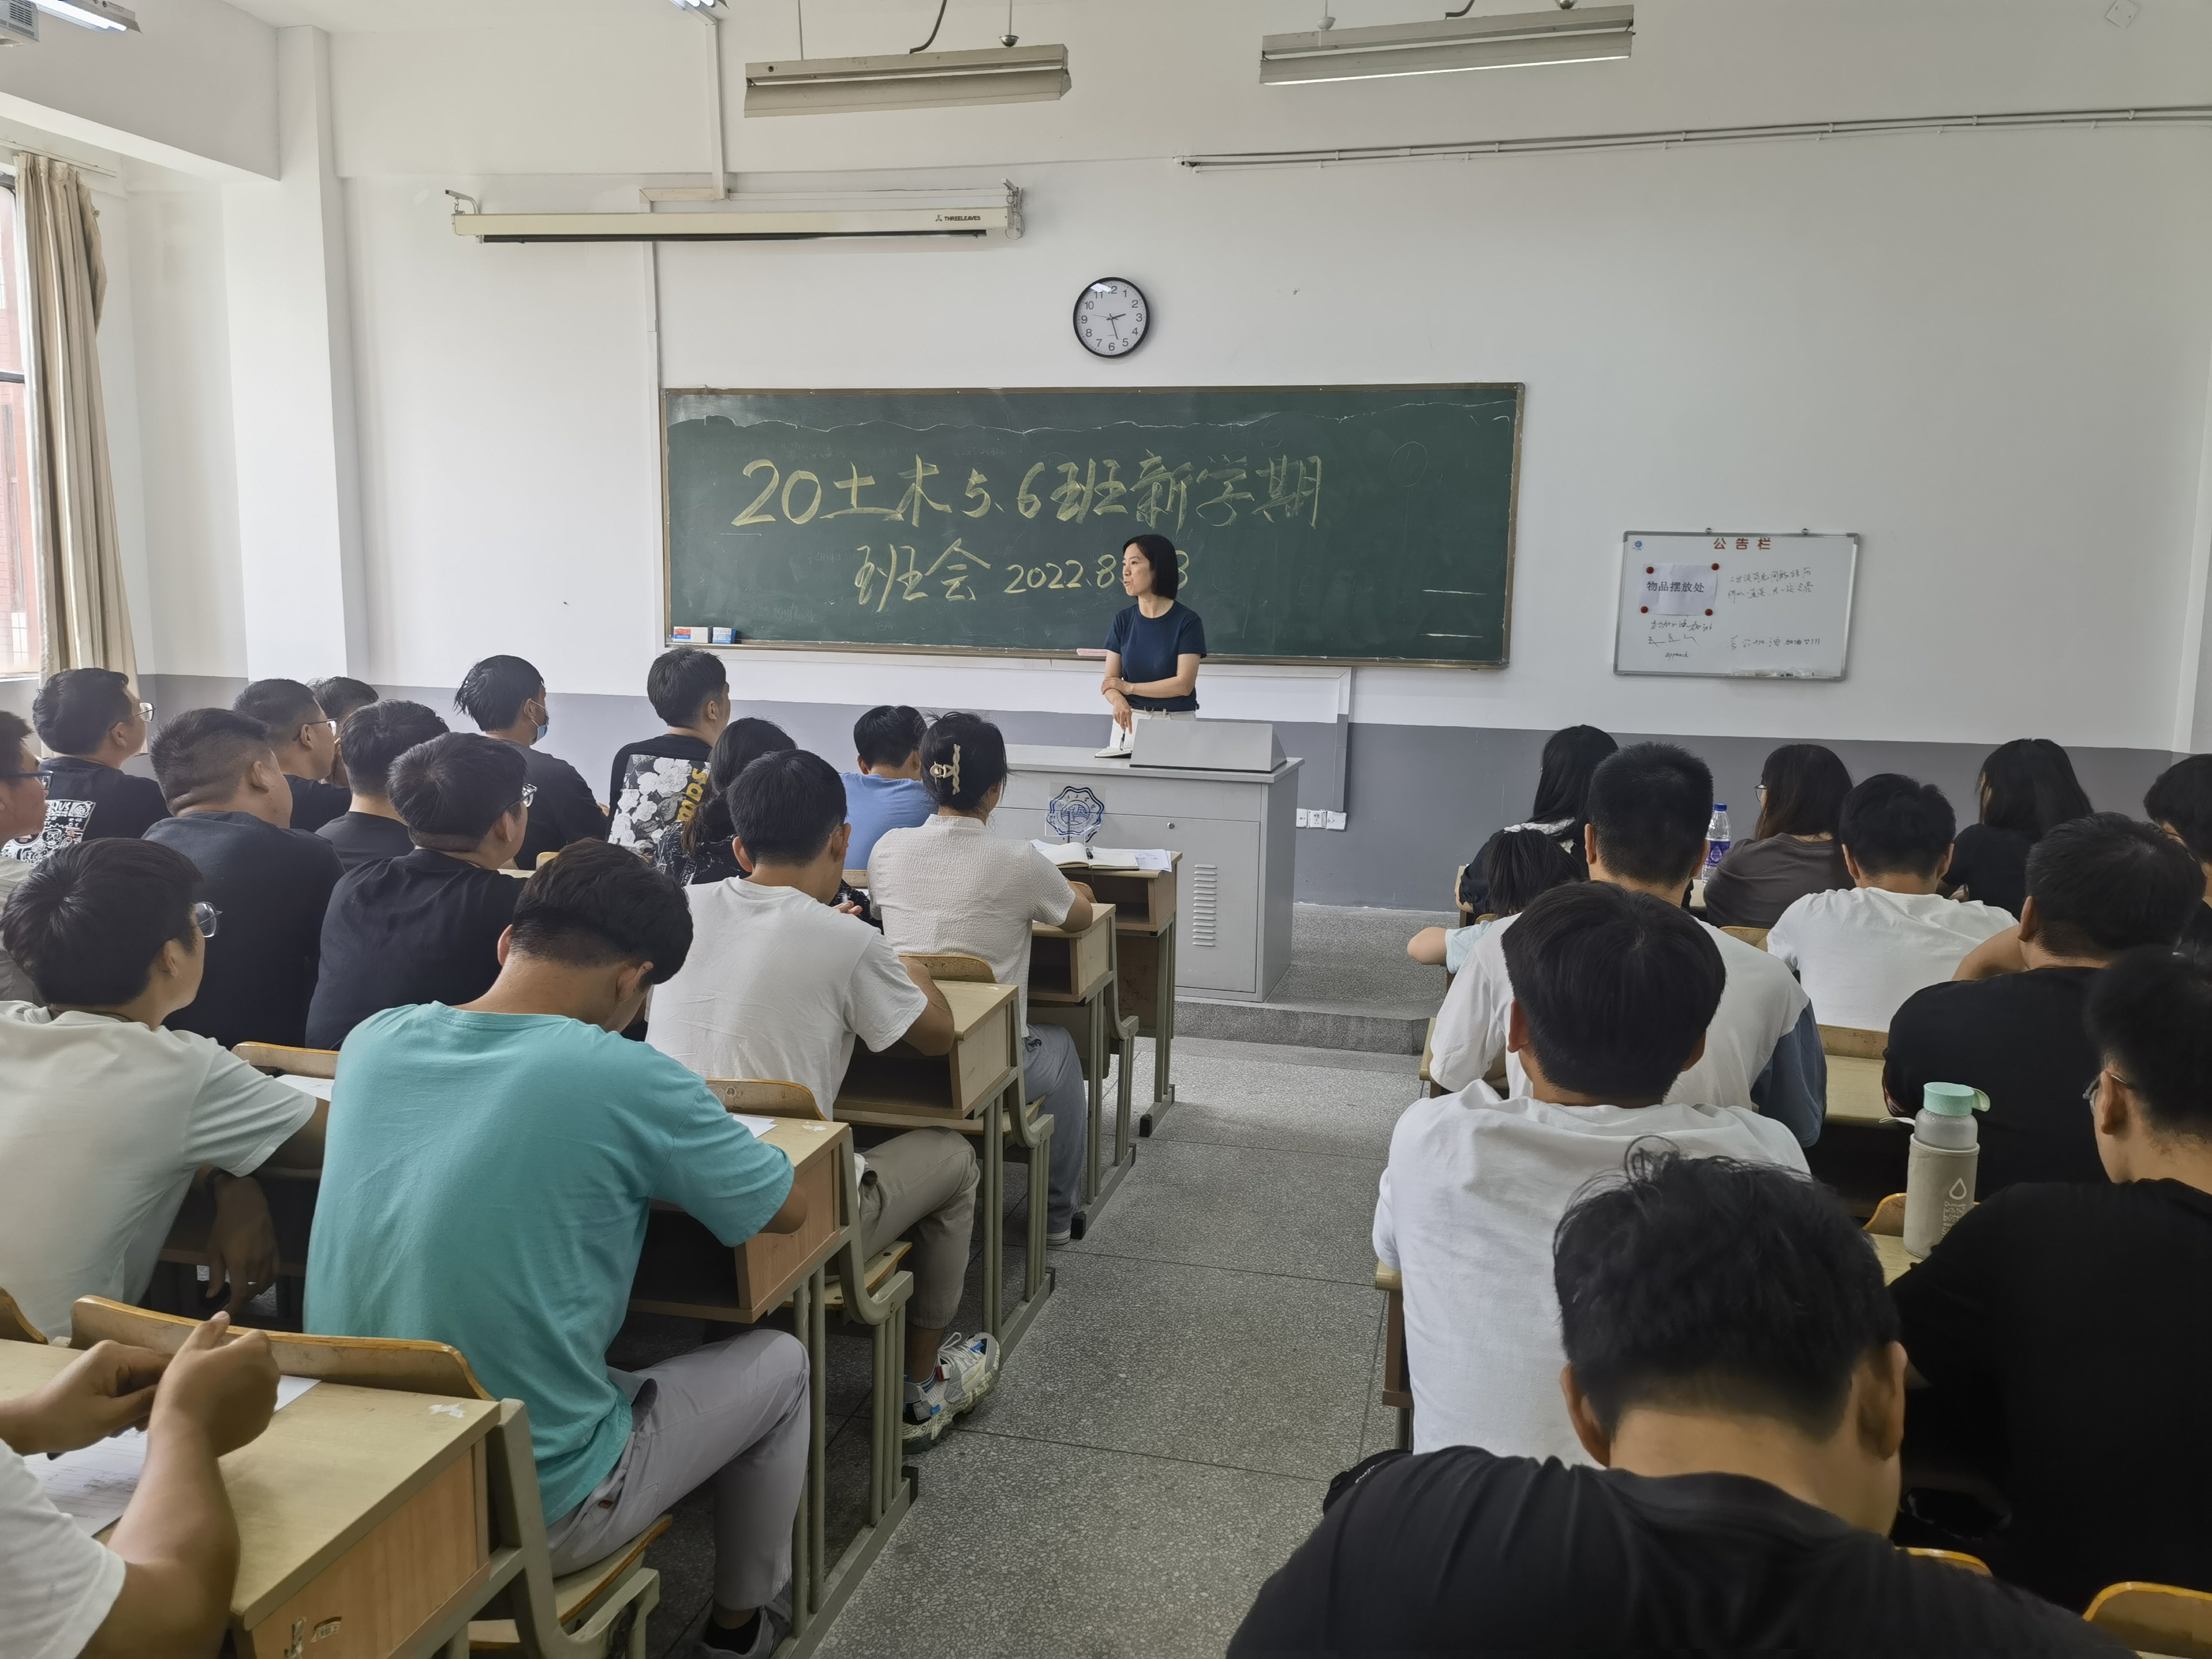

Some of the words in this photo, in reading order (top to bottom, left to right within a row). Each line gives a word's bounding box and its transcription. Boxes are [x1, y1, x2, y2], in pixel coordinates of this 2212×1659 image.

[1123, 289, 1127, 298] 1
[1084, 301, 1094, 310] 10
[1131, 300, 1138, 308] 2
[1081, 315, 1088, 324] 9
[1136, 313, 1142, 322] 3
[1085, 328, 1092, 337] 8
[1132, 327, 1138, 335] 4
[1096, 339, 1102, 347] 7
[1108, 342, 1115, 351] 6
[1122, 338, 1129, 347] 5
[1714, 537, 1771, 550] 公告栏
[853, 537, 992, 613] 班会
[1646, 581, 1704, 592] 物品摆放处
